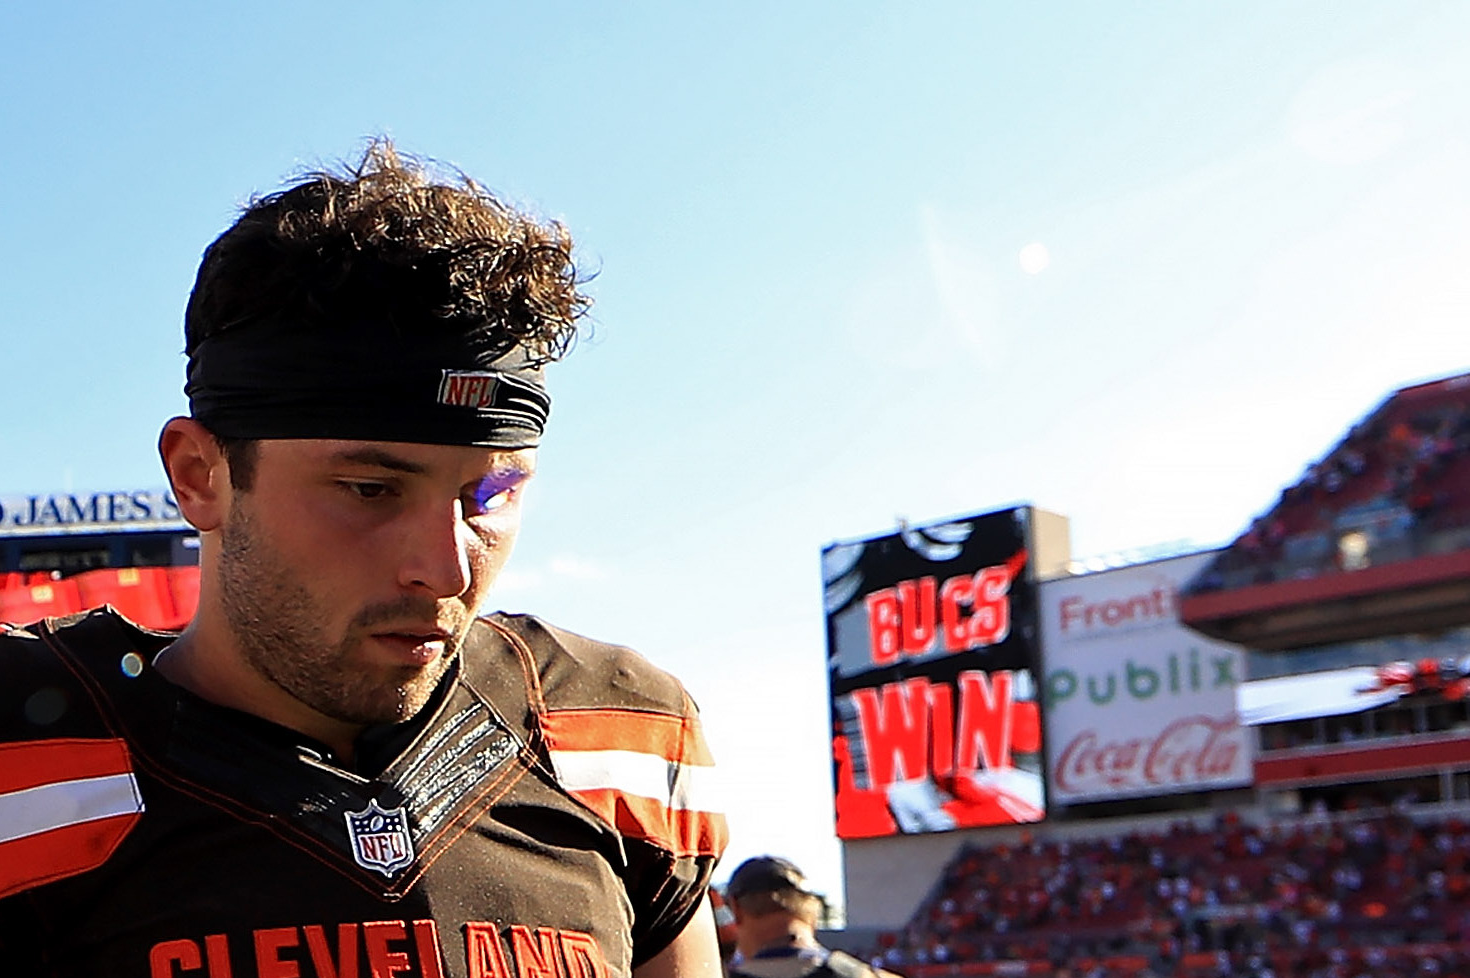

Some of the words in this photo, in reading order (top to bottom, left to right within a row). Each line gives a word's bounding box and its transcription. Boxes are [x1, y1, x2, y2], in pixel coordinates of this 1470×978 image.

[445, 376, 493, 408] NFL
[14, 490, 151, 526] JAMES
[865, 565, 1012, 665] BUCS
[852, 671, 1013, 791] WIN
[359, 833, 404, 863] NFL
